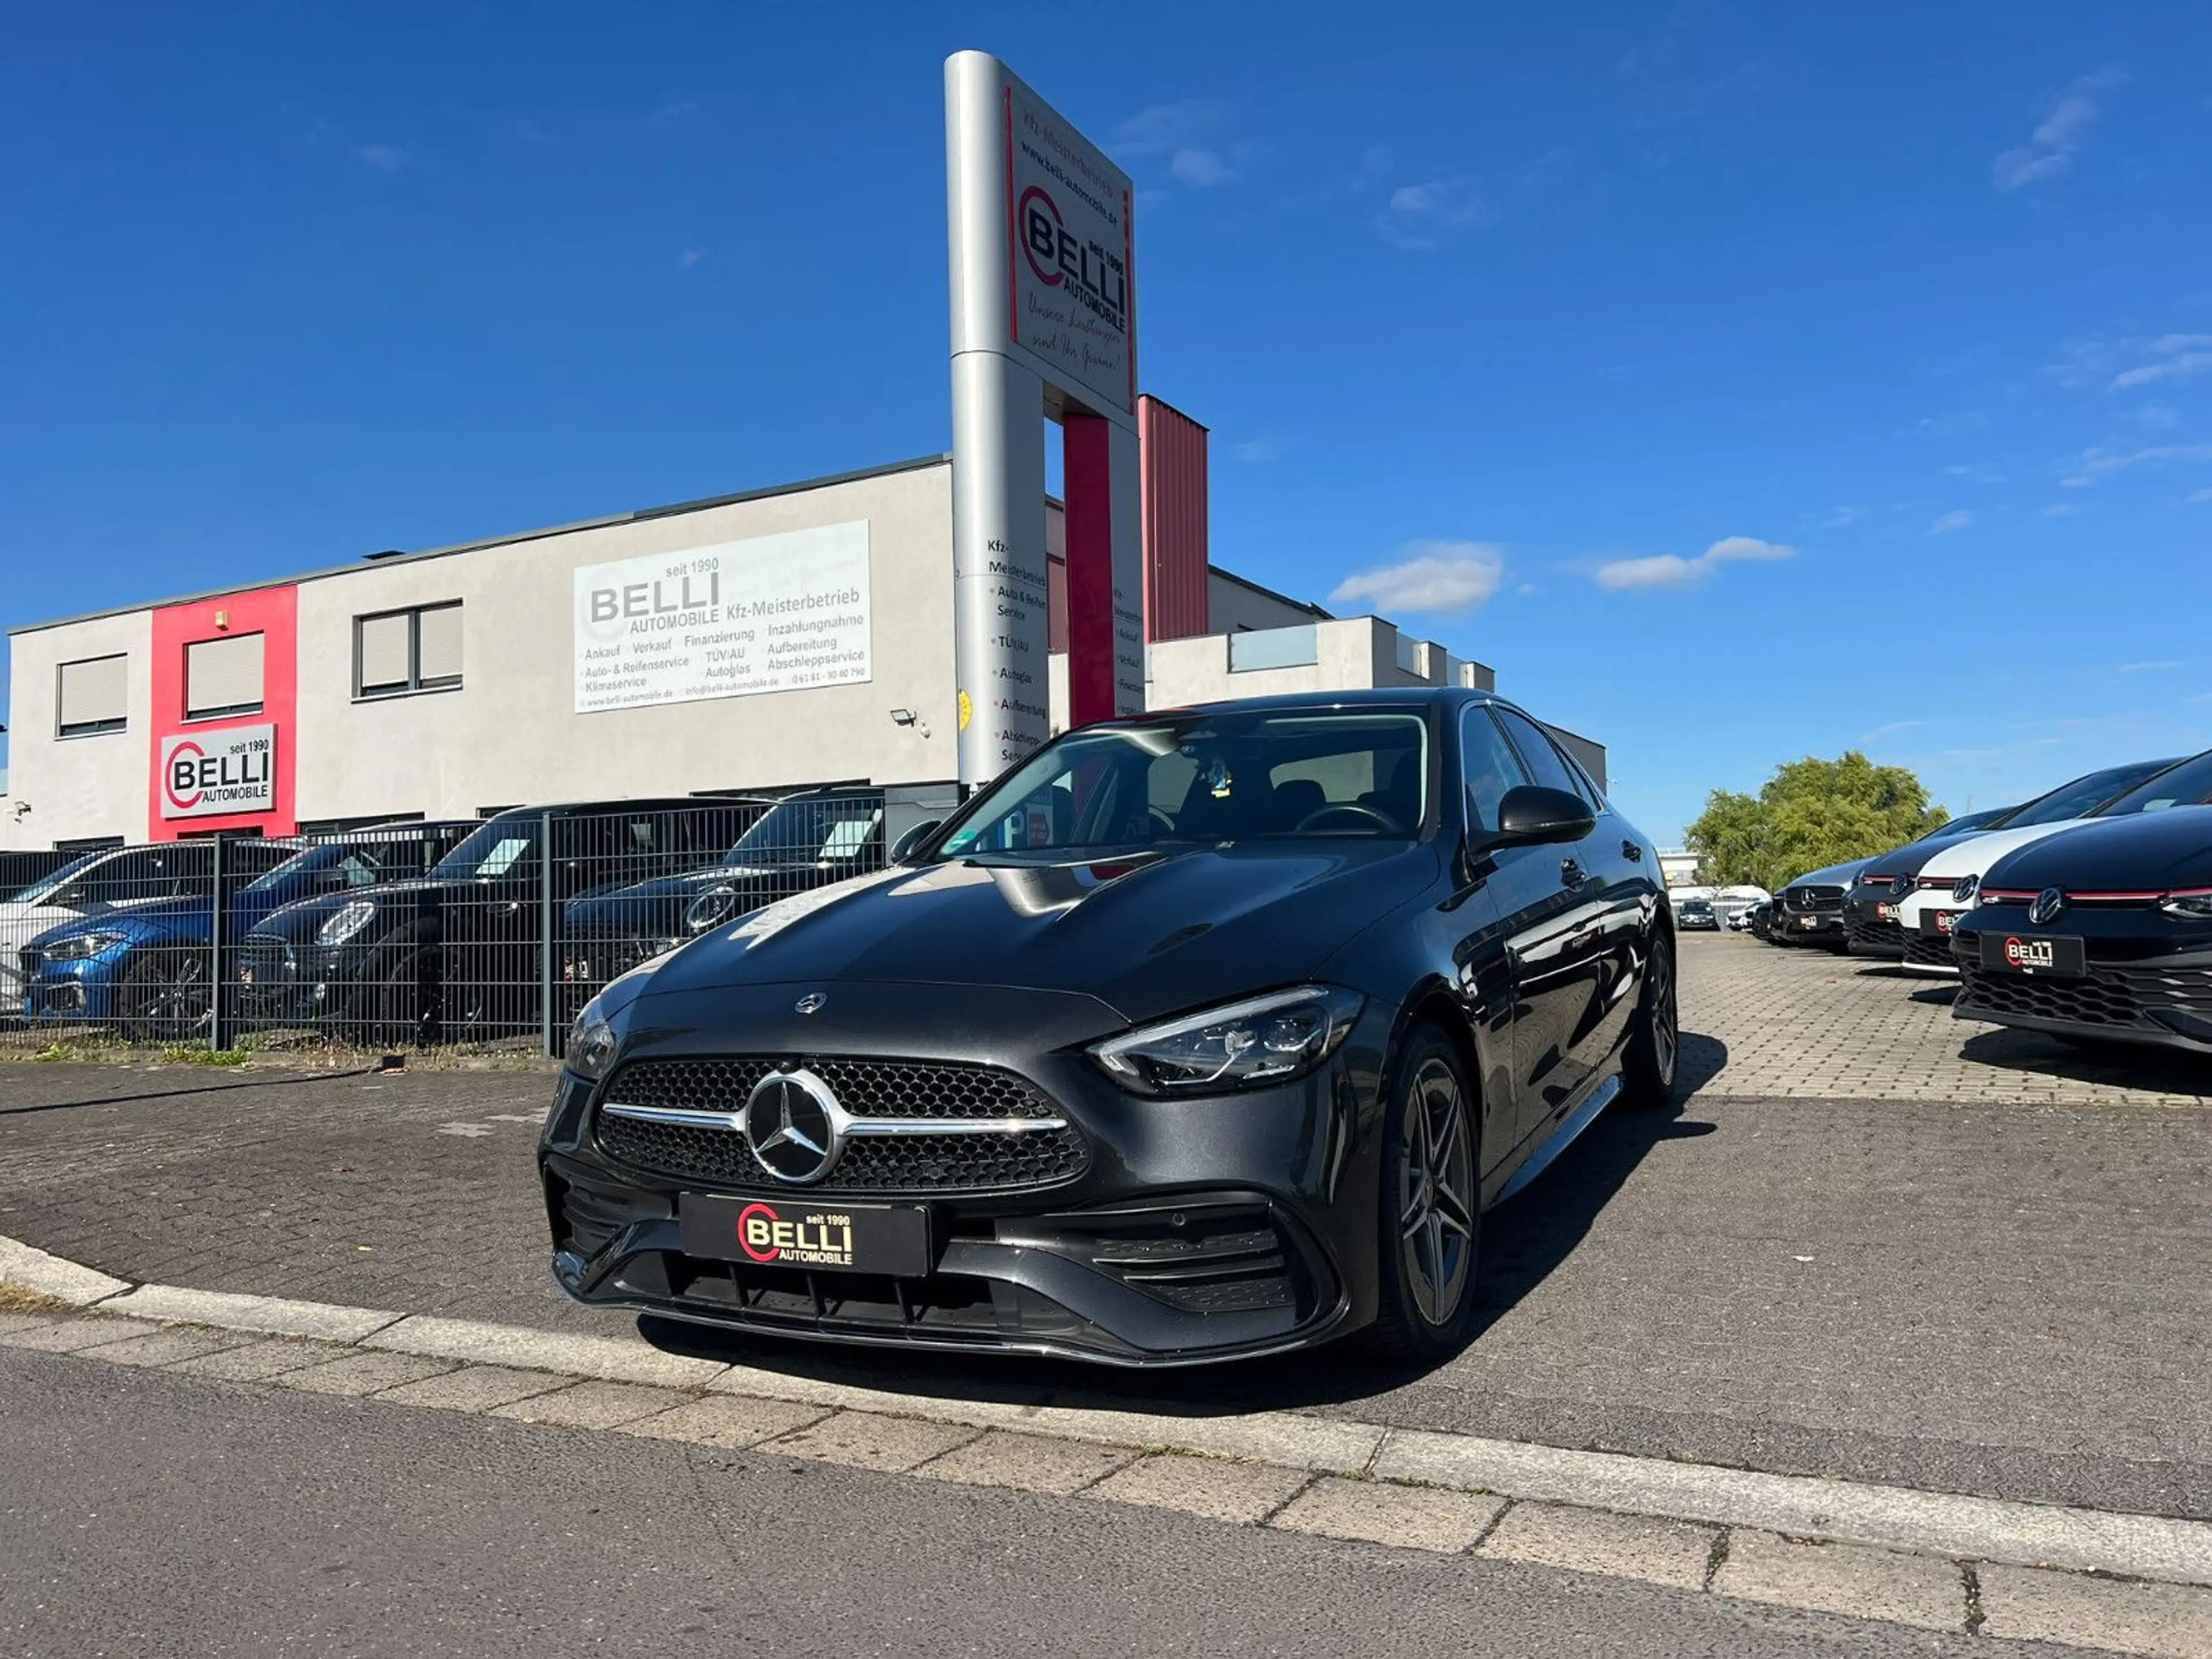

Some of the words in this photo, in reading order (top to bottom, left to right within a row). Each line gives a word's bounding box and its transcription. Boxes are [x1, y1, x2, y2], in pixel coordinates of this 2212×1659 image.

[1029, 207, 1125, 316] BELLI
[1065, 277, 1125, 334] AUTOMOBILE
[988, 540, 1009, 552] Kfz-
[665, 563, 687, 577] seit
[691, 557, 718, 573] 1990
[592, 572, 718, 623] BELLI
[630, 609, 719, 634] AUTOMOBILE
[727, 588, 859, 620] Kfz-Meisterbetrieb
[585, 645, 620, 660] Ankauf
[633, 637, 672, 654] Verkauf
[685, 630, 755, 647] Finanzierung
[768, 614, 863, 636] Inzahlungnahme
[586, 677, 646, 692] Klimaservice
[706, 664, 750, 679] Autoglas
[767, 649, 864, 671] Abschleppservice
[613, 664, 620, 675] &
[623, 657, 688, 673] Reifenservice
[767, 637, 837, 654] Aufbereitung
[229, 743, 246, 754] seit
[249, 739, 269, 752] 1990
[175, 752, 268, 790] BELLI
[202, 785, 268, 802] AUTOMOBILE
[2009, 944, 2052, 961] BELLI
[747, 1218, 853, 1252] BELLI
[806, 1214, 824, 1225] seit
[827, 1215, 850, 1226] 1990
[779, 1249, 853, 1265] AUTOMOBILE
